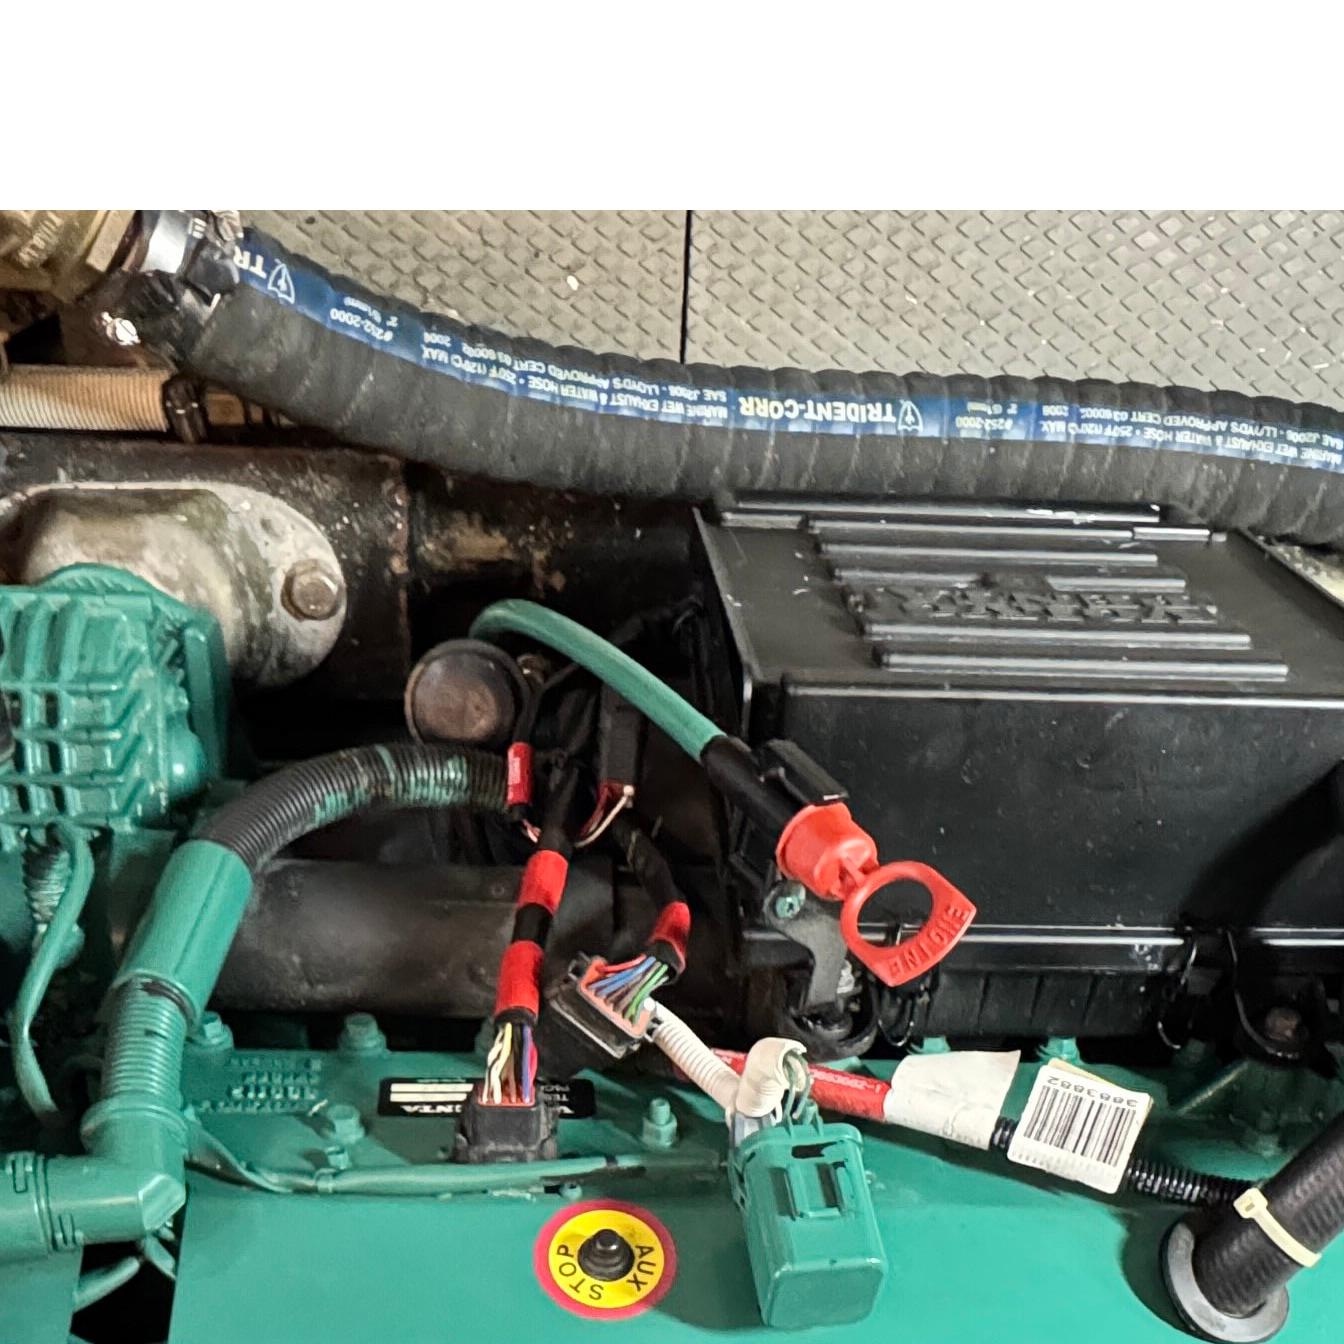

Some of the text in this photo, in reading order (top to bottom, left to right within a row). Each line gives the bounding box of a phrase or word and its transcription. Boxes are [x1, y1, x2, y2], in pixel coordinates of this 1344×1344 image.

[512, 359, 546, 375] CERT
[548, 364, 611, 389] APPROVED
[527, 375, 558, 395] HOSE
[561, 383, 598, 403] WATER
[611, 392, 659, 413] EXHAUST
[703, 389, 727, 402] SAE
[662, 400, 686, 416] WET
[686, 404, 729, 418] MARINE
[738, 396, 897, 424] TRIDENT-CORR
[1131, 411, 1162, 425] CERT
[1163, 414, 1229, 433] APPROVED
[1143, 427, 1173, 442] HOSE
[1175, 430, 1212, 446] WATER
[1322, 434, 1344, 450] SAE
[1225, 437, 1274, 457] EXHAUST
[1276, 444, 1299, 459] WET
[1301, 446, 1343, 466] MARINE
[557, 1244, 604, 1300] STOP
[626, 1244, 656, 1292] AUX
